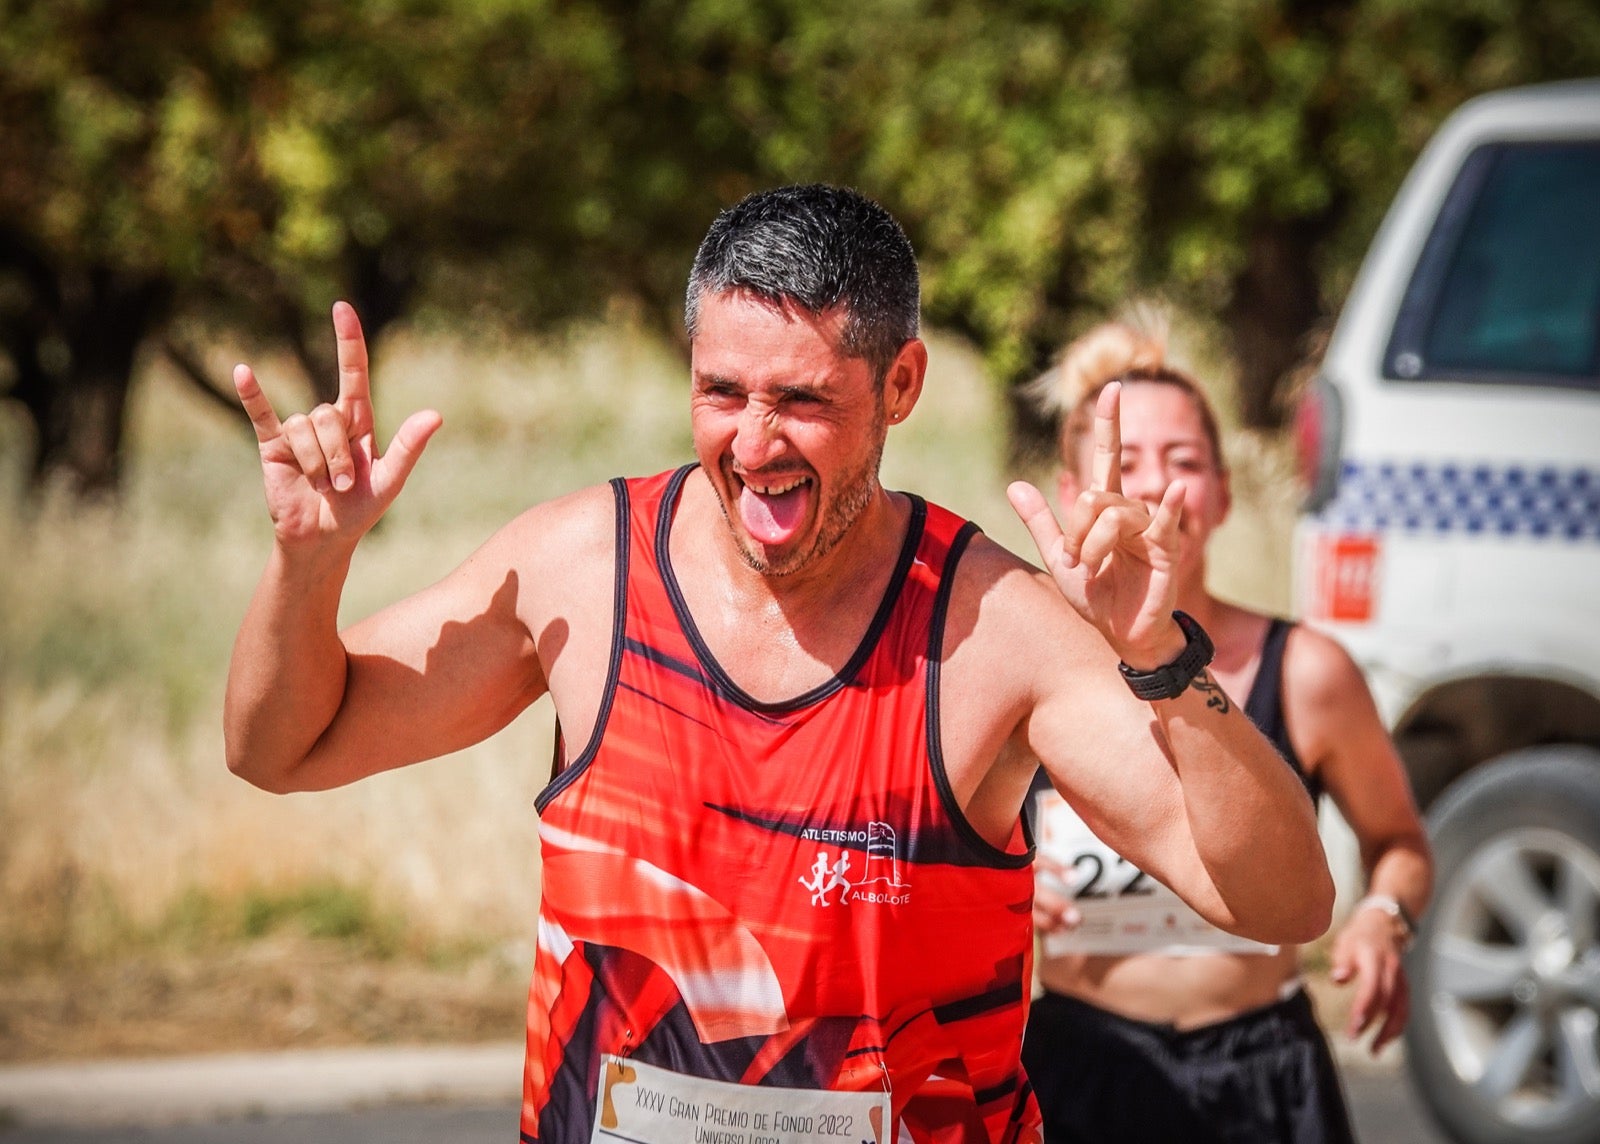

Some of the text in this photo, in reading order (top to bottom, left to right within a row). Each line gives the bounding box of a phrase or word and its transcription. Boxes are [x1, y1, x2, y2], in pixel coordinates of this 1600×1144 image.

[800, 828, 867, 843] ATLETISMO
[851, 890, 911, 905] ALBOLOTE
[635, 1085, 854, 1137] XXXV GRAN PREMIO DE FONDO 2022
